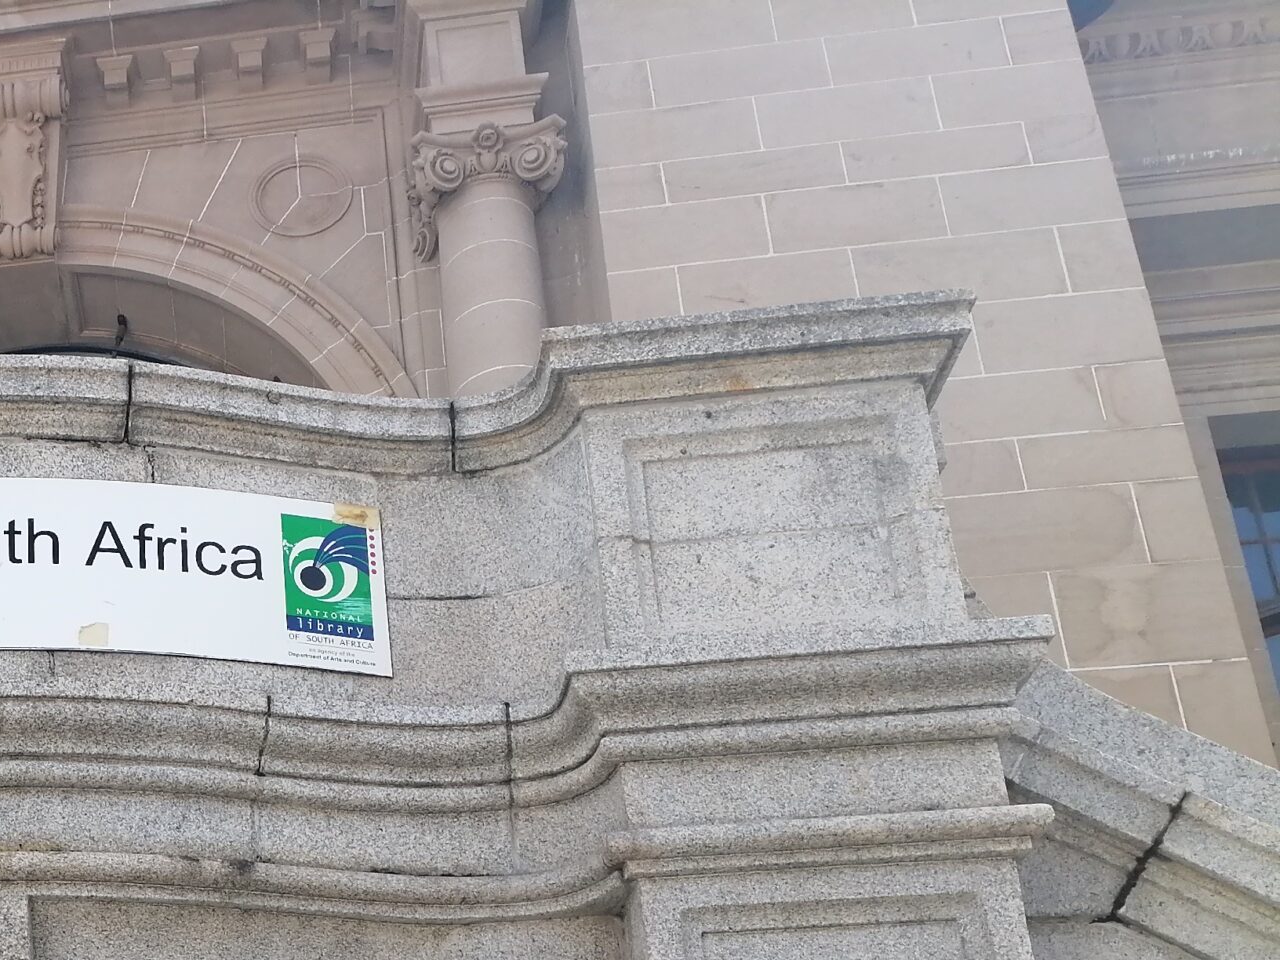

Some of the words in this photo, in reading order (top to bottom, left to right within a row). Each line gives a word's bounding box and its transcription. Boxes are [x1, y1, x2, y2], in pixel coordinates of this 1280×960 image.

[84, 520, 265, 581] Africa
[296, 608, 363, 622] NATIONAL
[297, 617, 364, 638] library
[288, 633, 300, 641] OF
[306, 635, 334, 644] SOUTH
[340, 639, 374, 649] AFRICA
